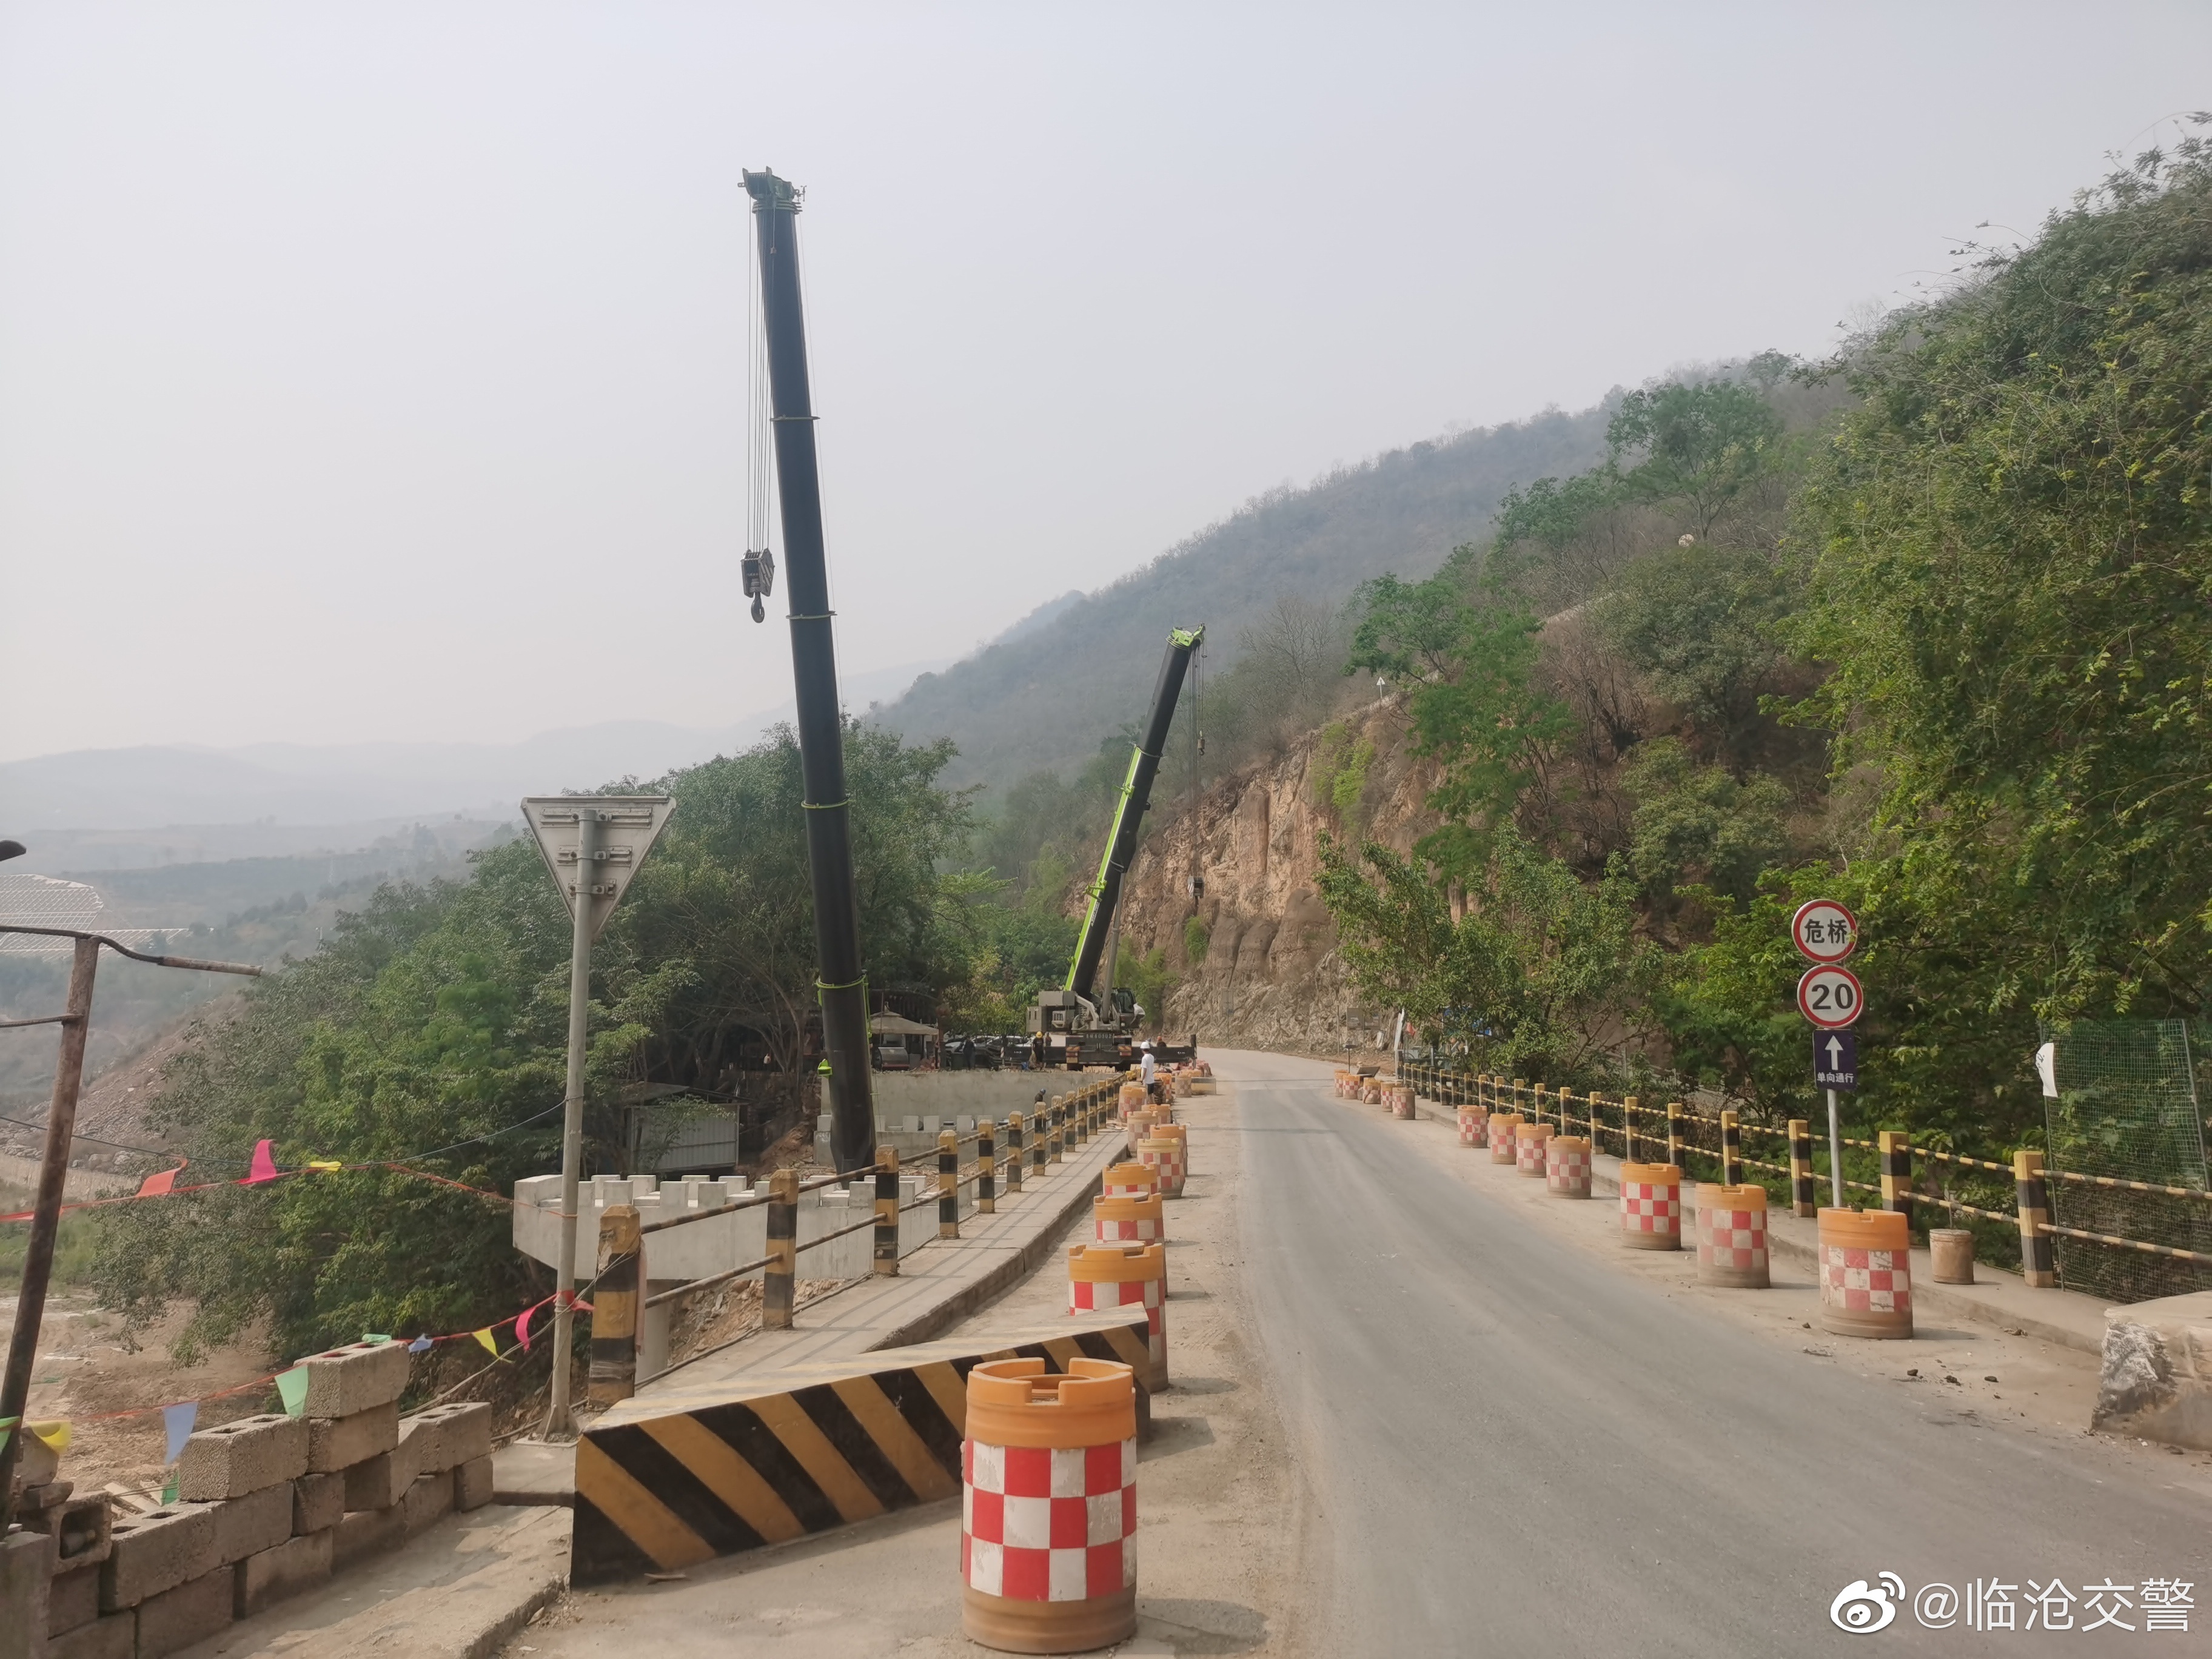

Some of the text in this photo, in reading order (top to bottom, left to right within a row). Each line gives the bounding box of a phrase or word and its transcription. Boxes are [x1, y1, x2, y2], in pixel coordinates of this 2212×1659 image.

[1804, 919, 1848, 944] 危桥
[1811, 983, 1854, 1010] 20
[1817, 1071, 1854, 1083] 单向通行
